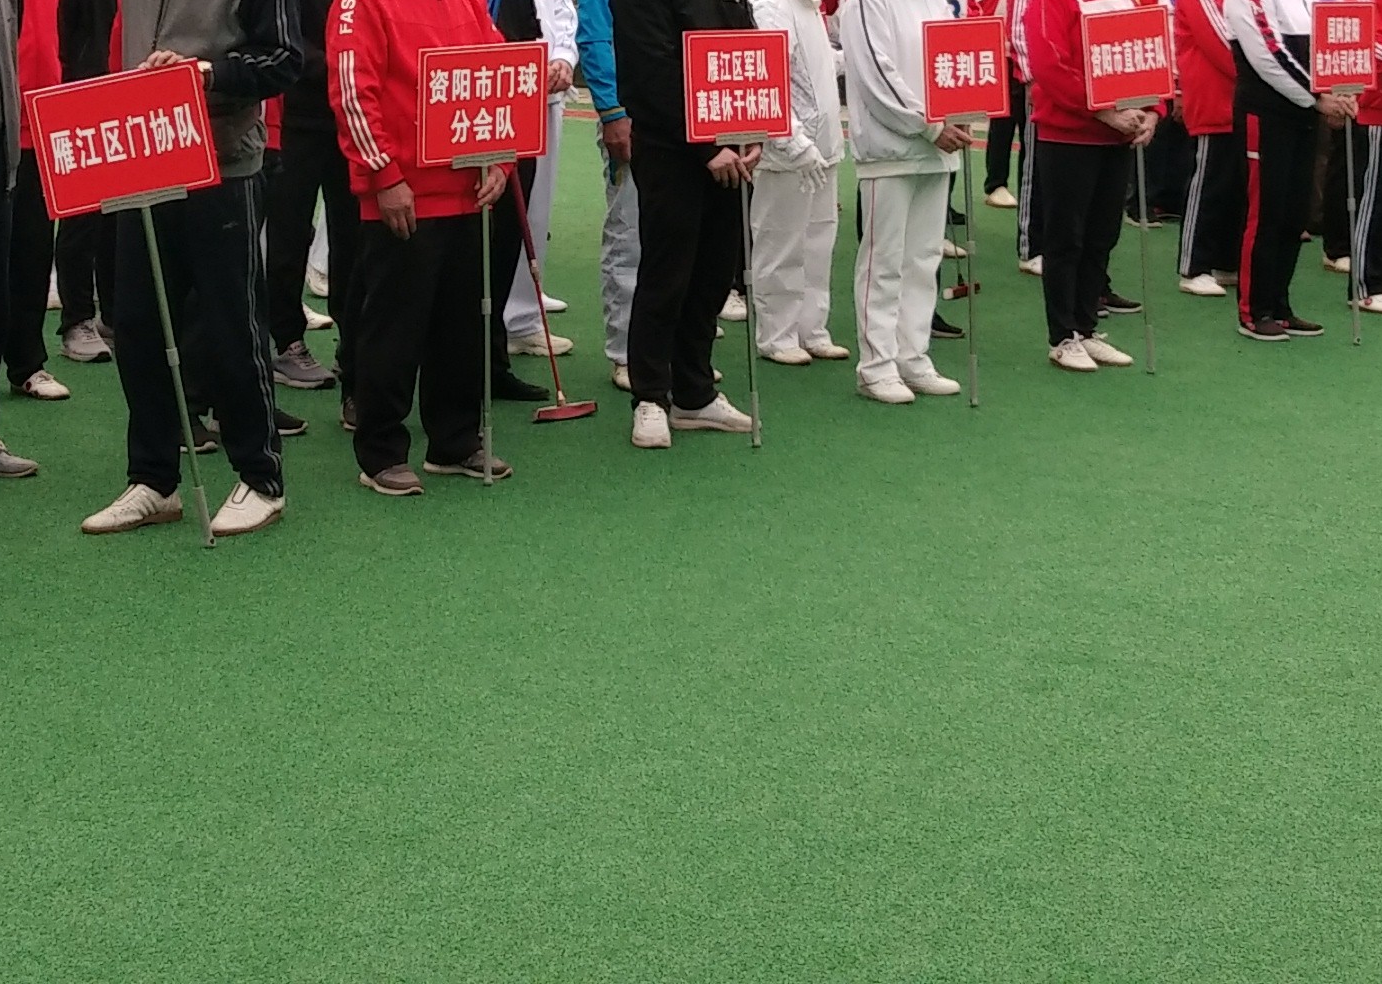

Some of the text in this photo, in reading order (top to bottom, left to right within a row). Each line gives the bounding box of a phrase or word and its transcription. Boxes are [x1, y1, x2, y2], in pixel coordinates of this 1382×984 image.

[707, 48, 769, 84] 雁江区军队
[934, 50, 998, 88] 裁判员
[1090, 35, 1167, 78] 资阳市直机关队
[428, 62, 539, 105] 资阳市门球
[450, 104, 516, 144] 分会队
[696, 86, 783, 123] 离退休干休所队
[49, 102, 202, 176] 雁江区门协队
